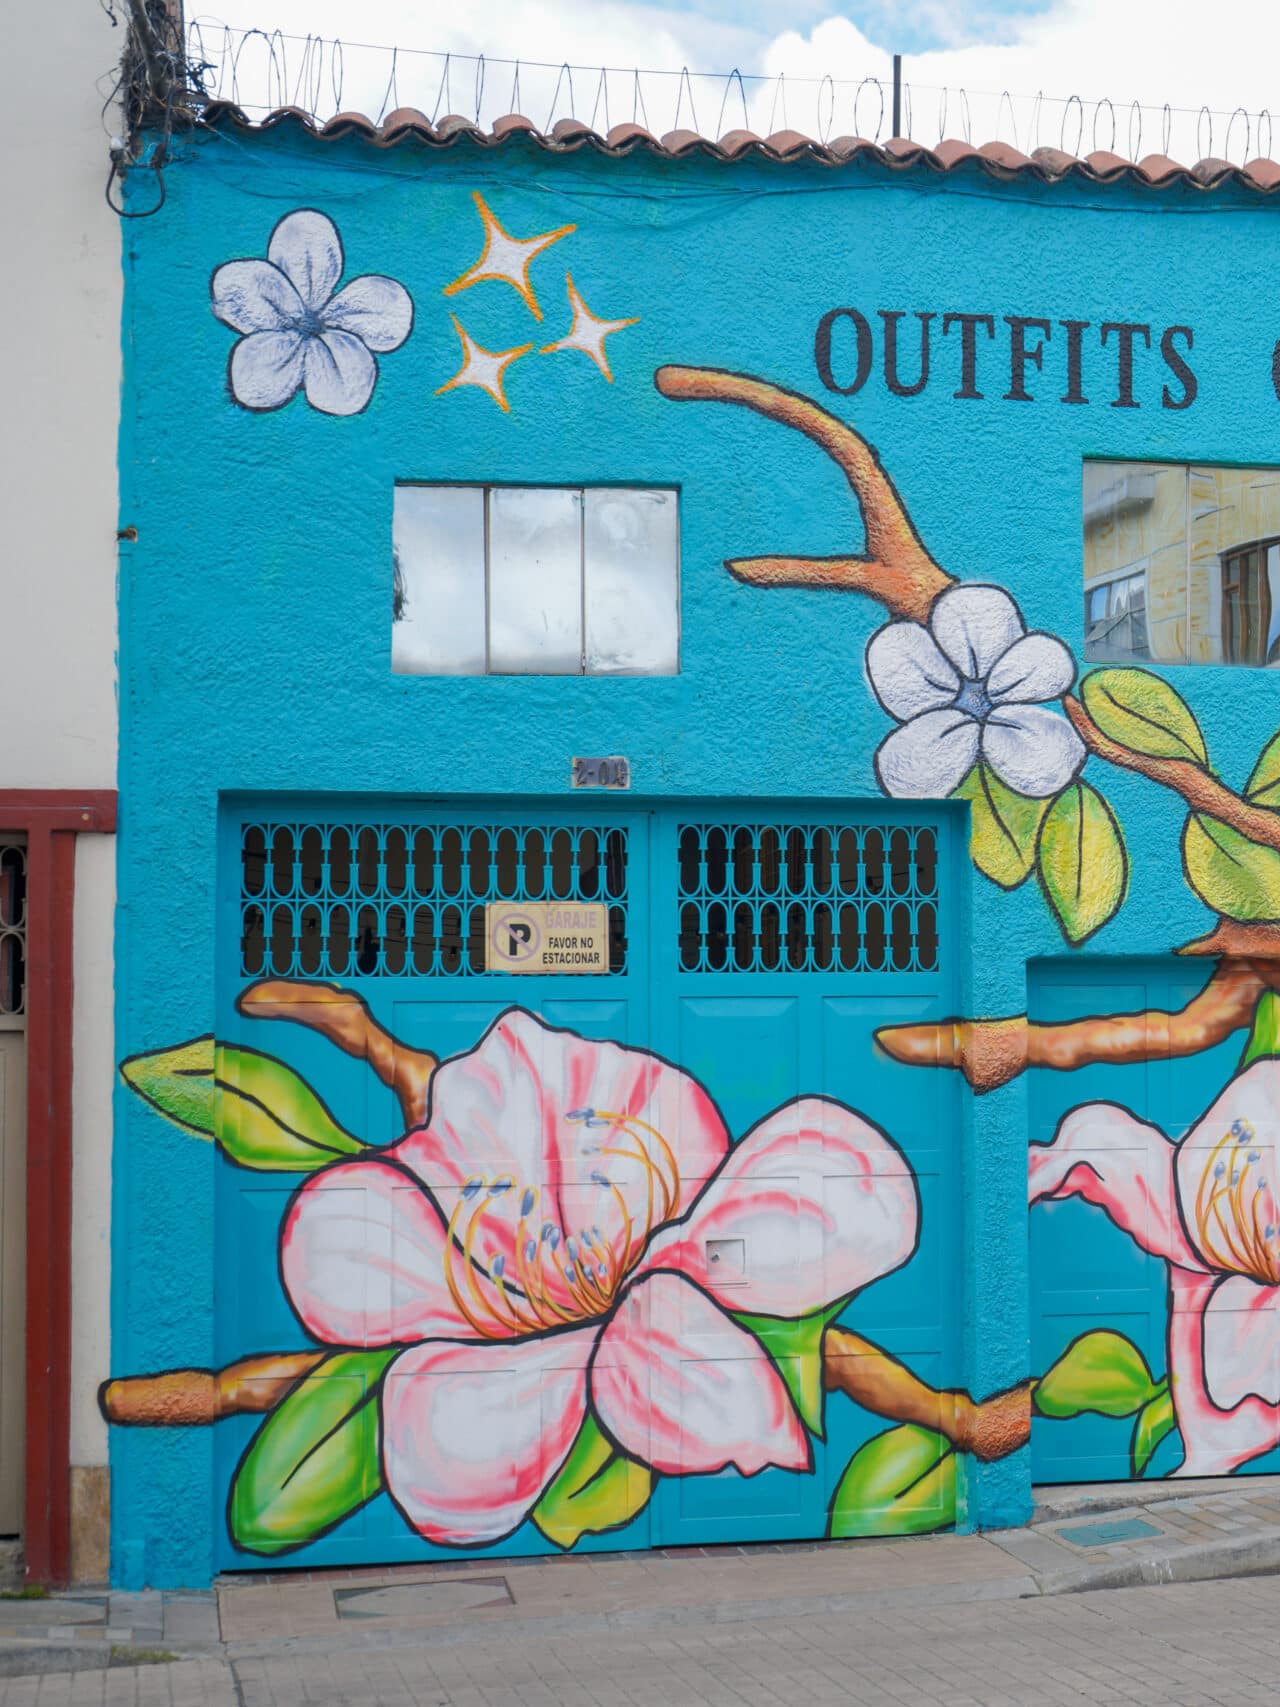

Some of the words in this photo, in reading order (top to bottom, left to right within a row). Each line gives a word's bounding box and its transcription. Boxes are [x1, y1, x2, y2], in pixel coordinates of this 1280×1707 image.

[813, 307, 1200, 410] OUTFITS
[545, 910, 596, 929] GARAJE
[548, 936, 578, 949] FAVOR
[580, 936, 594, 949] NO
[542, 952, 600, 964] ESTACIONAR
